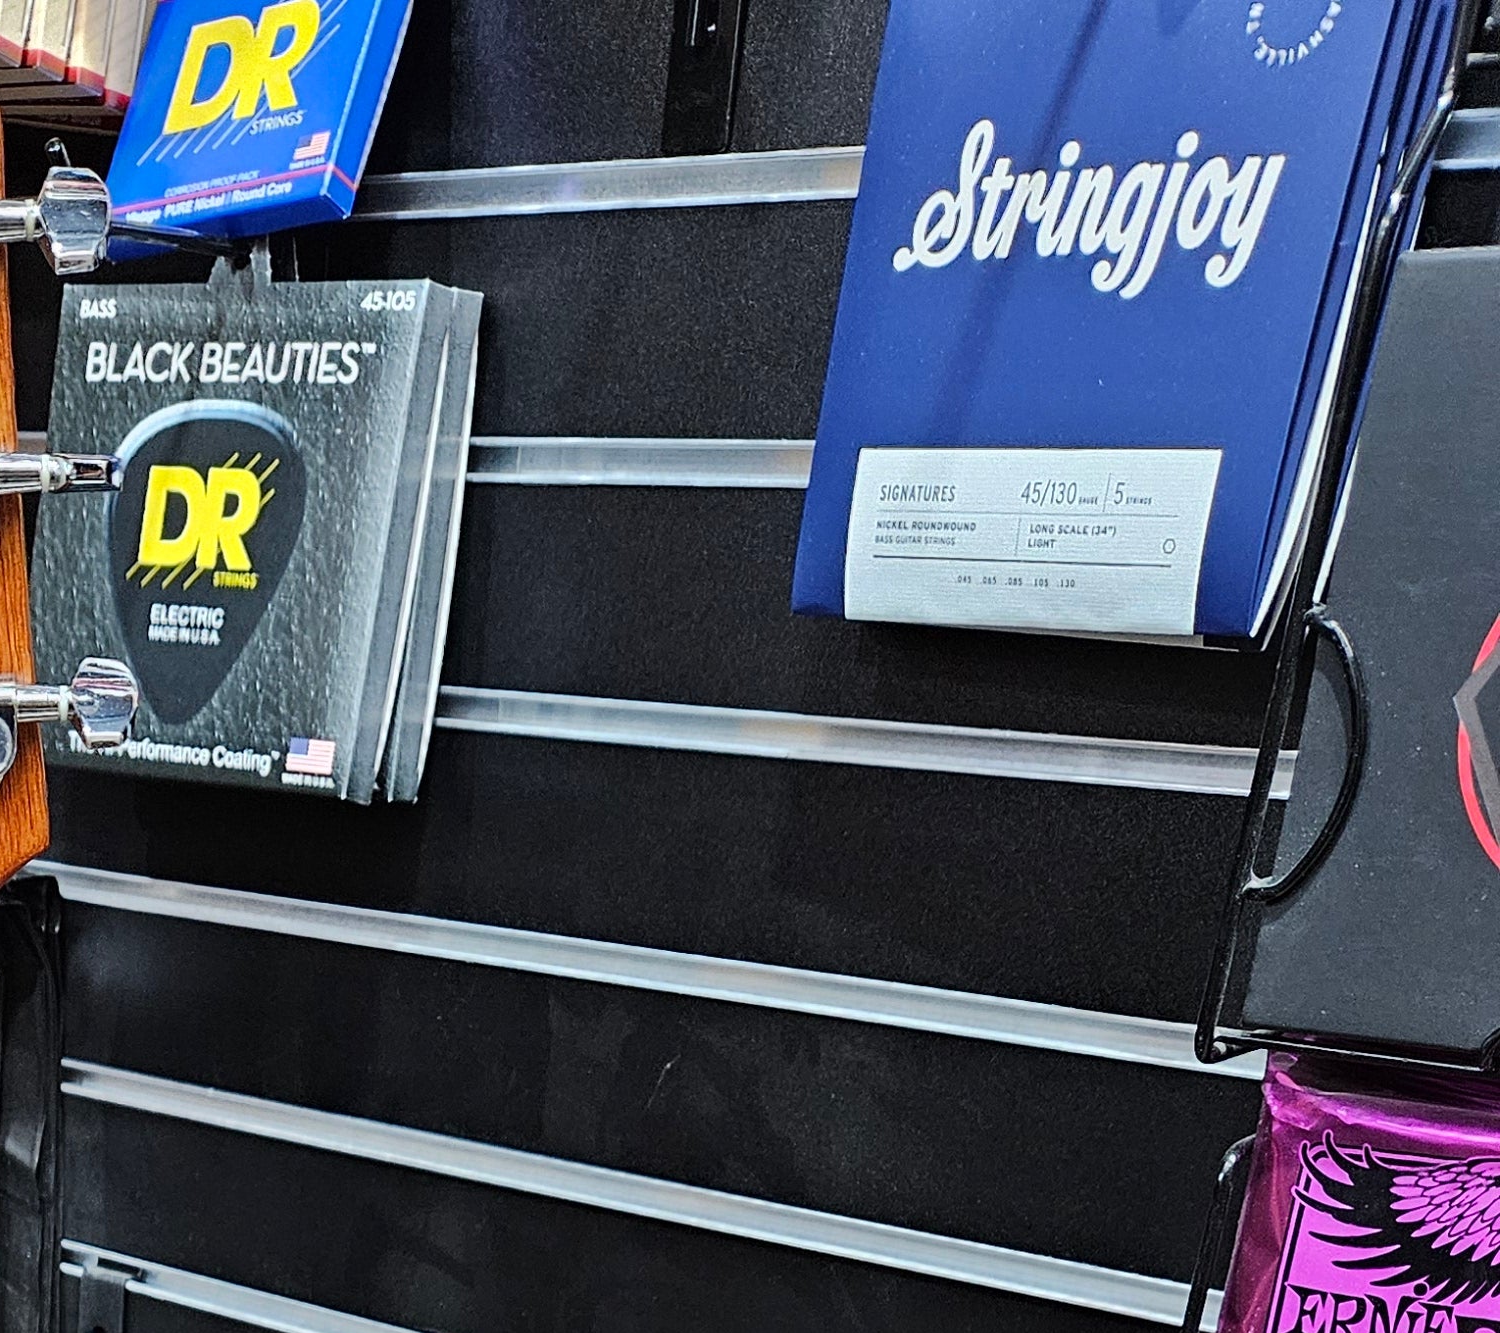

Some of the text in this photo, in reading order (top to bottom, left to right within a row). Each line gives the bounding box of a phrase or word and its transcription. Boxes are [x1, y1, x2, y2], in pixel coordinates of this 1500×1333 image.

[163, 0, 321, 136] DR
[250, 111, 304, 135] STRINGS
[164, 197, 193, 218] PURE
[233, 187, 265, 205] Round
[267, 180, 293, 198] Core
[893, 119, 1286, 299] Stringjoy
[80, 299, 116, 318] BASS
[86, 342, 194, 383] BLACK
[880, 478, 1126, 505] SIGNATURES 45/130 5
[138, 465, 262, 571] DR
[877, 520, 977, 532] NICKEL ROUNDWOUND
[1030, 524, 1055, 535] LONG
[1058, 524, 1089, 535] SCALE
[875, 535, 956, 546] BASS GUITAR STRINGS
[1028, 538, 1056, 549] LIGHT
[150, 603, 224, 627] ELECTRIC
